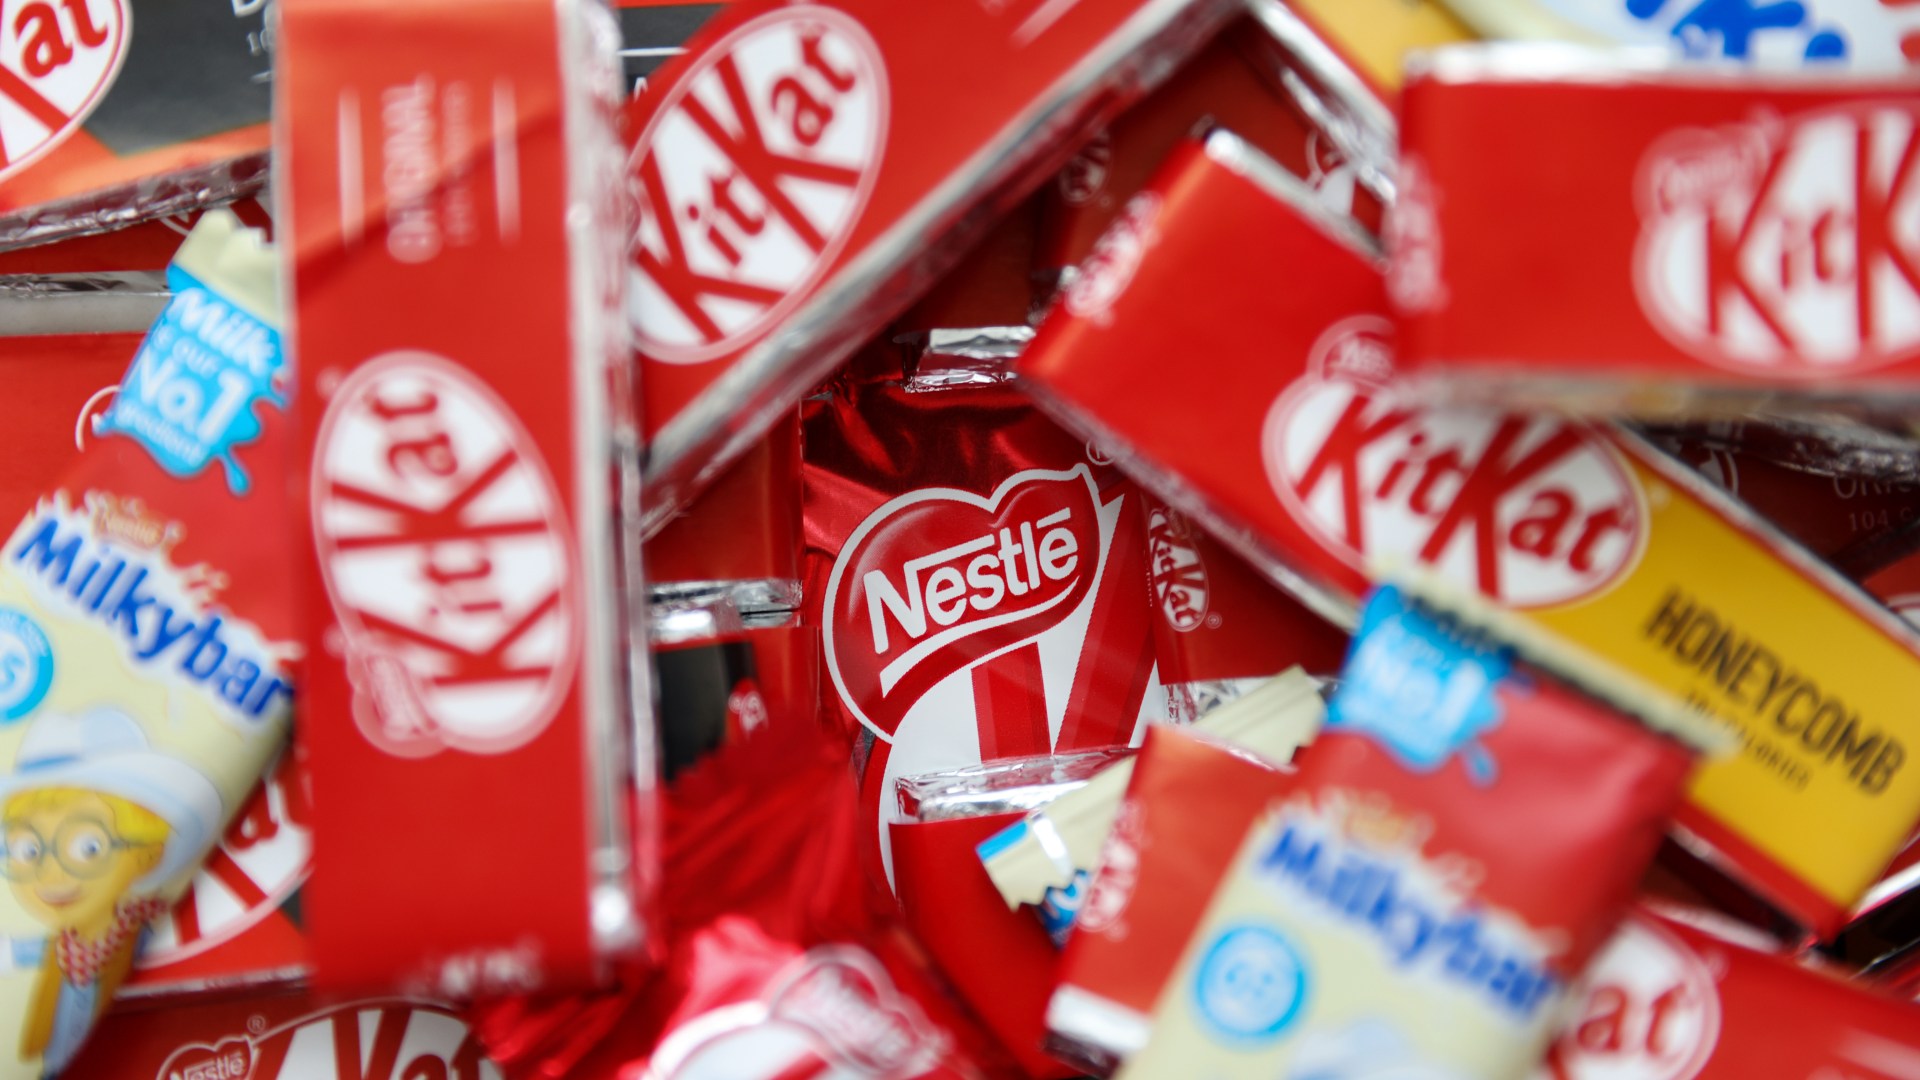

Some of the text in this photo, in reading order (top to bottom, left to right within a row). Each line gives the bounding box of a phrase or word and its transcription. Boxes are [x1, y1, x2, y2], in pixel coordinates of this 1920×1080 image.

[634, 20, 862, 342] KitKat
[166, 288, 276, 376] Milk
[333, 390, 562, 692] KitKat
[863, 508, 1081, 655] Nestlé
[1150, 522, 1204, 624] KitKat
[1292, 390, 1620, 600] KitKat
[1850, 511, 1889, 532] 104
[16, 517, 294, 718] Milkybar
[1648, 582, 1908, 798] HONEYCOMB
